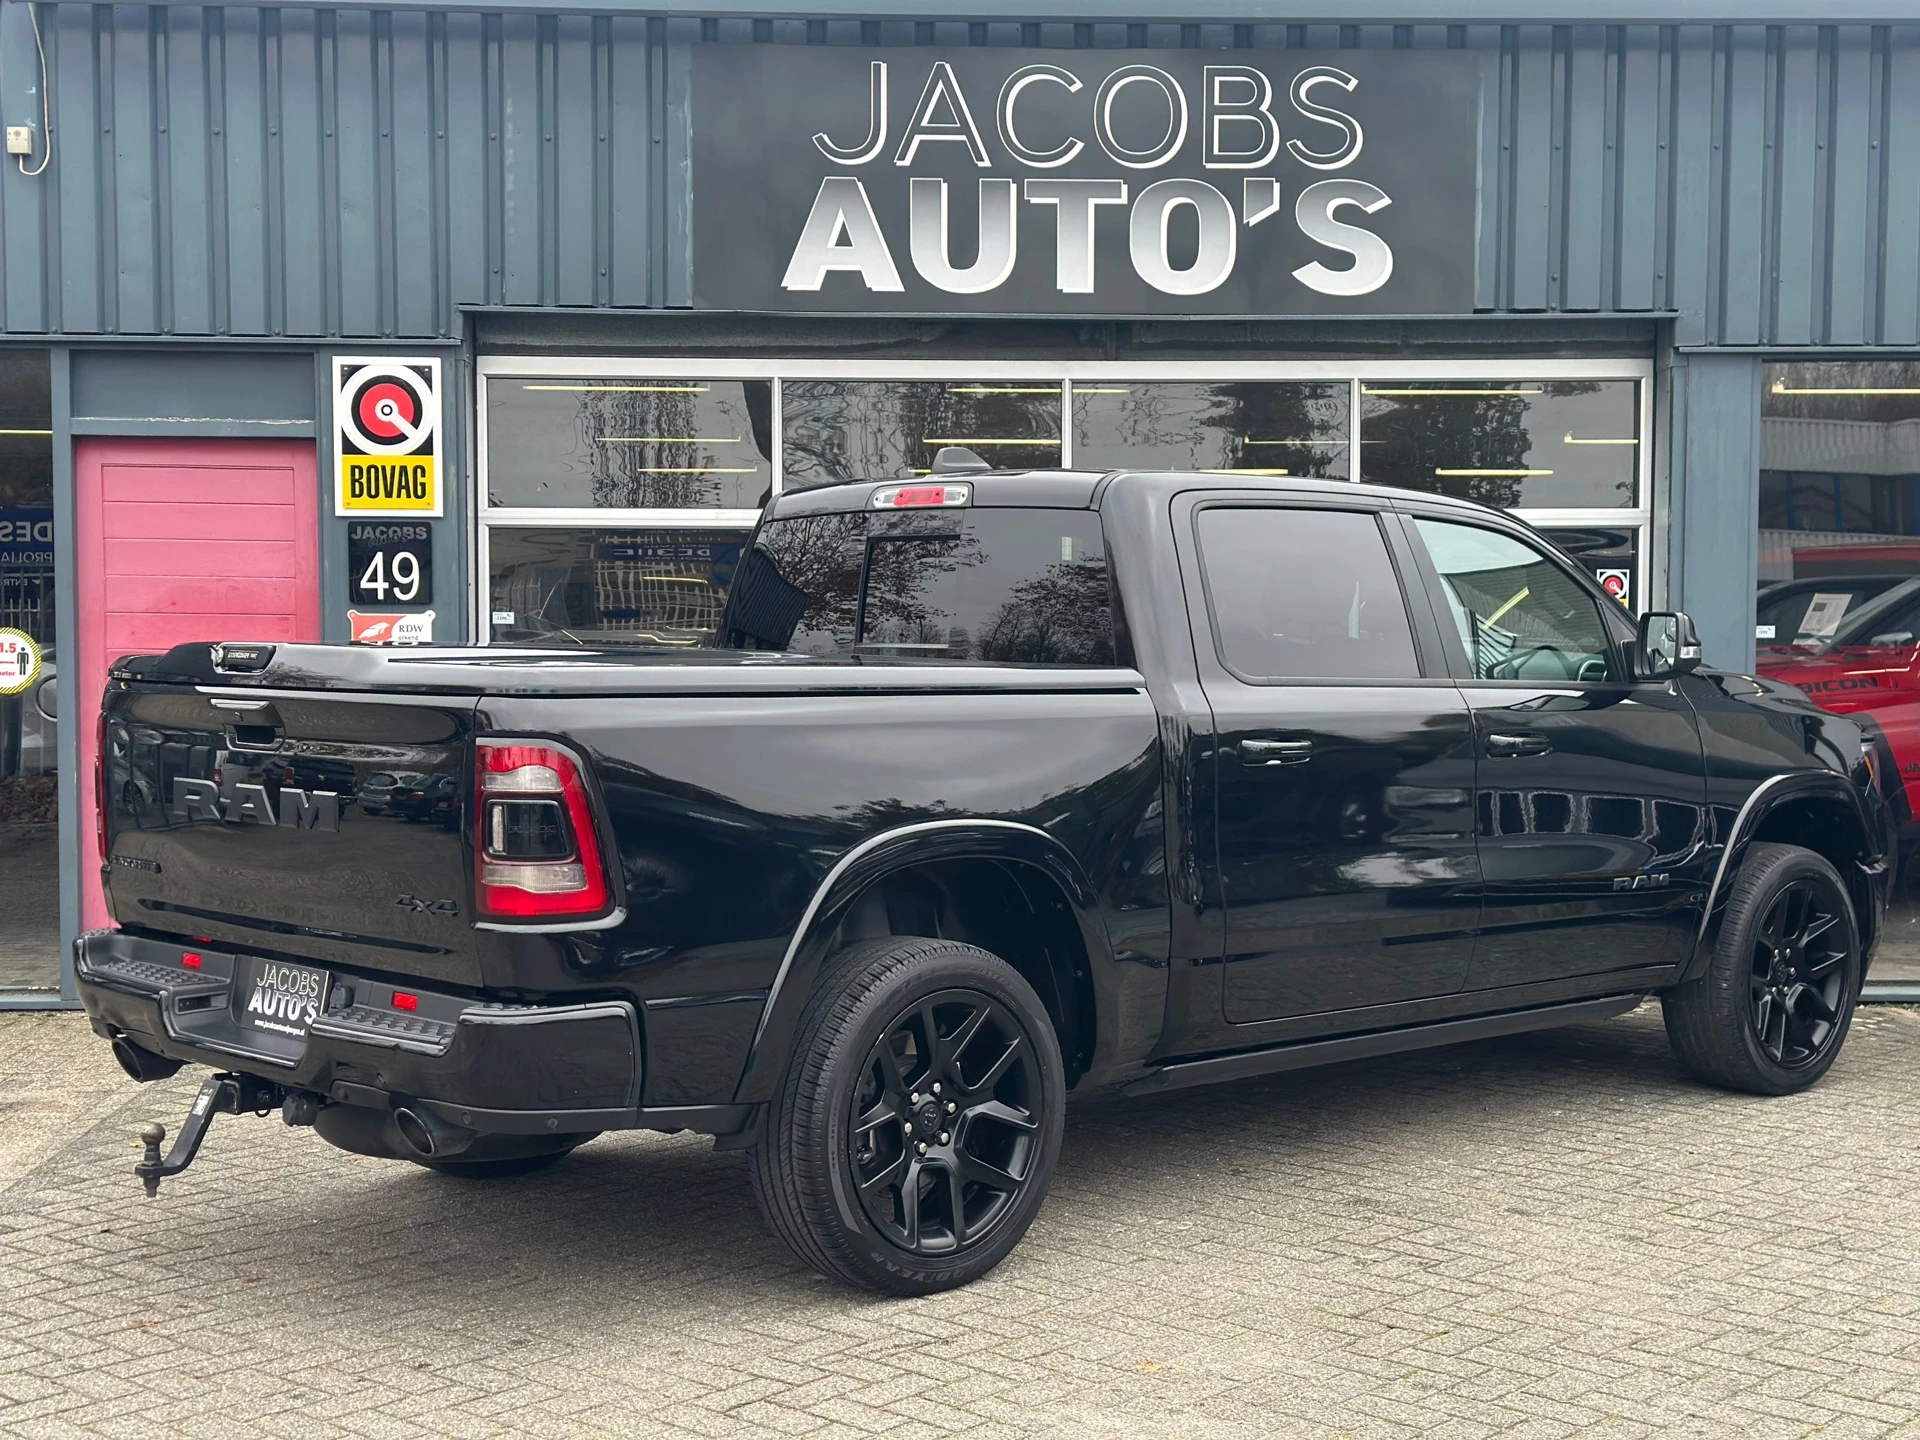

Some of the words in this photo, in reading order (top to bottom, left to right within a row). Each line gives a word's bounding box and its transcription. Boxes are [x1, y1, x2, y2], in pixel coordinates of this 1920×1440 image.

[811, 61, 1364, 169] JACOBS
[780, 176, 1394, 295] AUTO'S
[350, 464, 427, 499] BOVAG
[351, 526, 427, 540] JACOBS
[360, 551, 420, 601] 49
[398, 624, 424, 633] RDW
[173, 776, 340, 832] RAM
[1613, 873, 1670, 891] RAM
[256, 963, 319, 997] JACOBS
[247, 986, 319, 1025] AUTO'S
